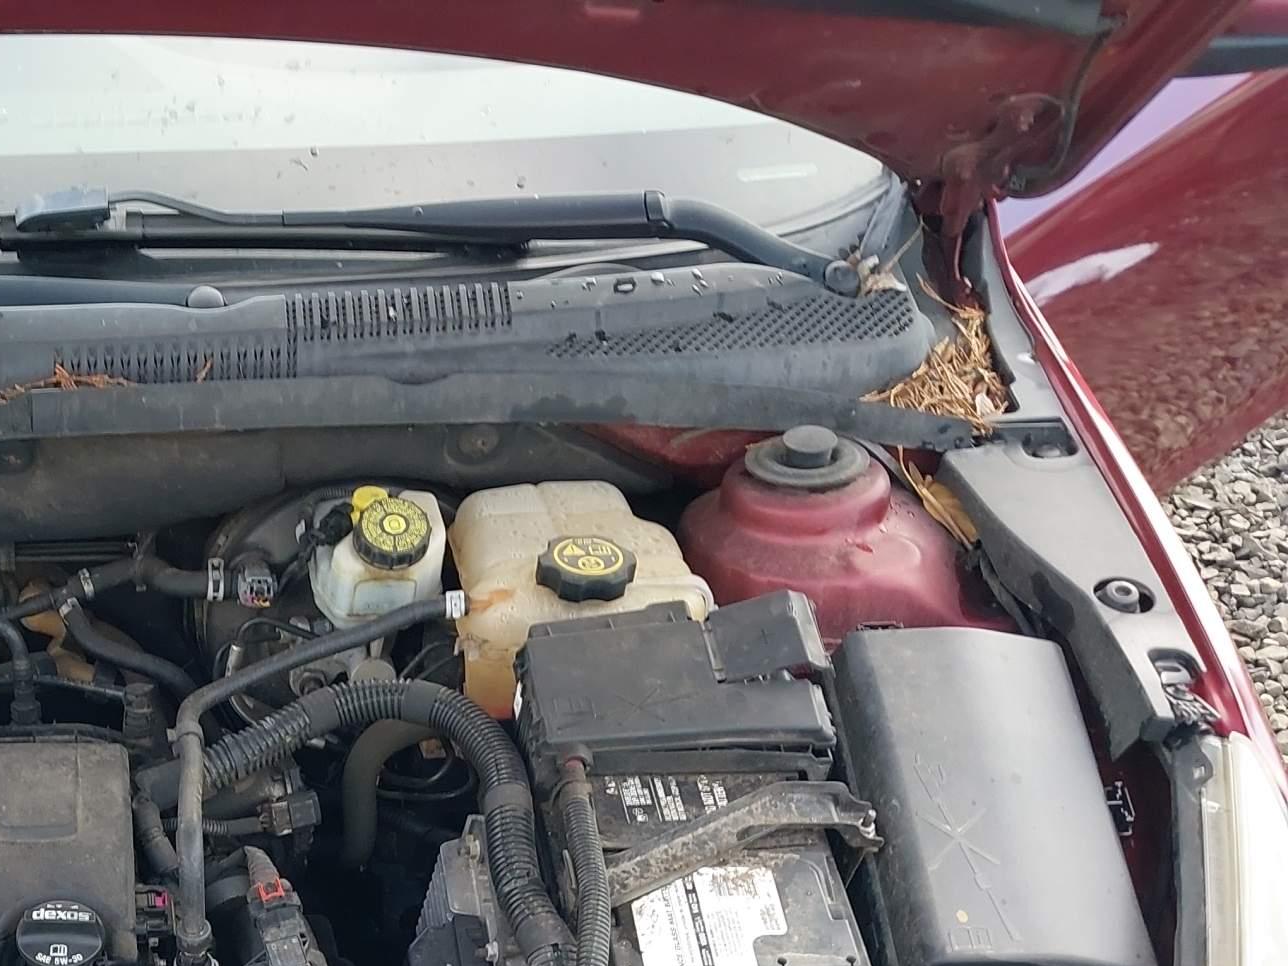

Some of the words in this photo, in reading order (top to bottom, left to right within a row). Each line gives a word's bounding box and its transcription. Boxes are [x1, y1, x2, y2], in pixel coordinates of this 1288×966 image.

[32, 907, 90, 921] dexos
[35, 952, 52, 965] SAE
[54, 953, 84, 966] 5W-30
